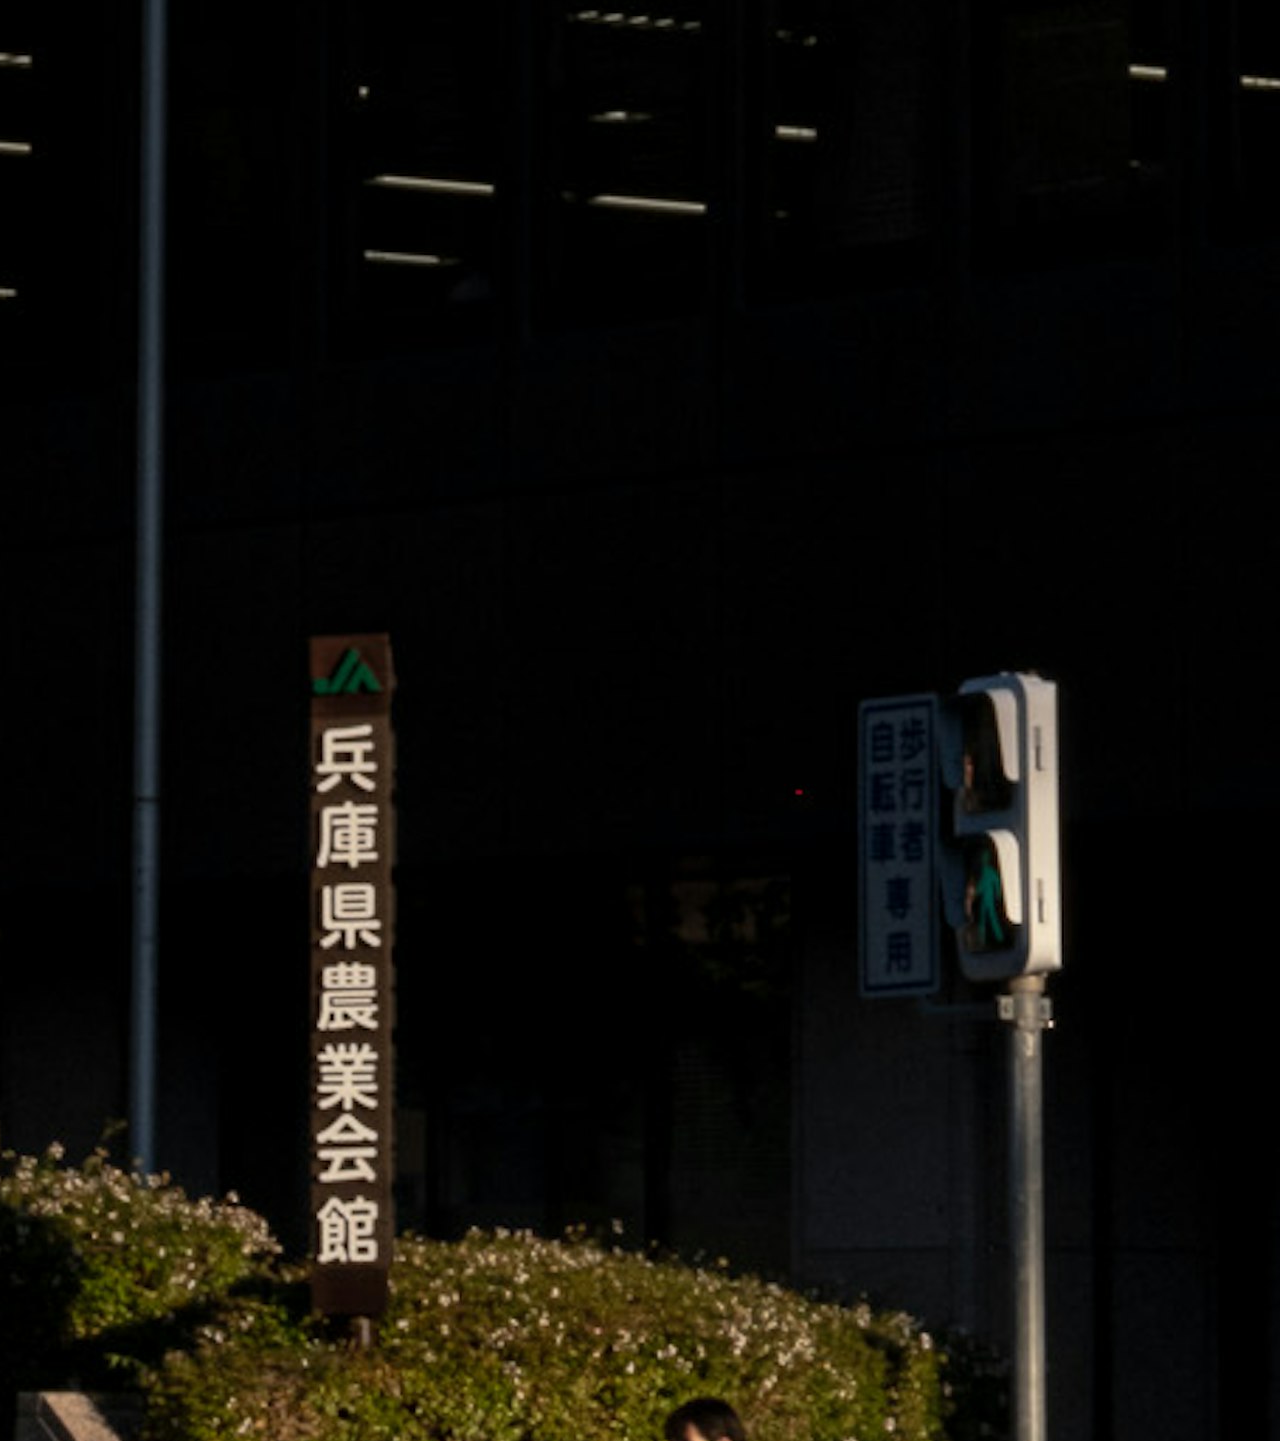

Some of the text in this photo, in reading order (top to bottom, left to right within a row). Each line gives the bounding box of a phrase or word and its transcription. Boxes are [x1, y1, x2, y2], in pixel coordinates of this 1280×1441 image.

[316, 723, 381, 1265] 兵庫県農業会館
